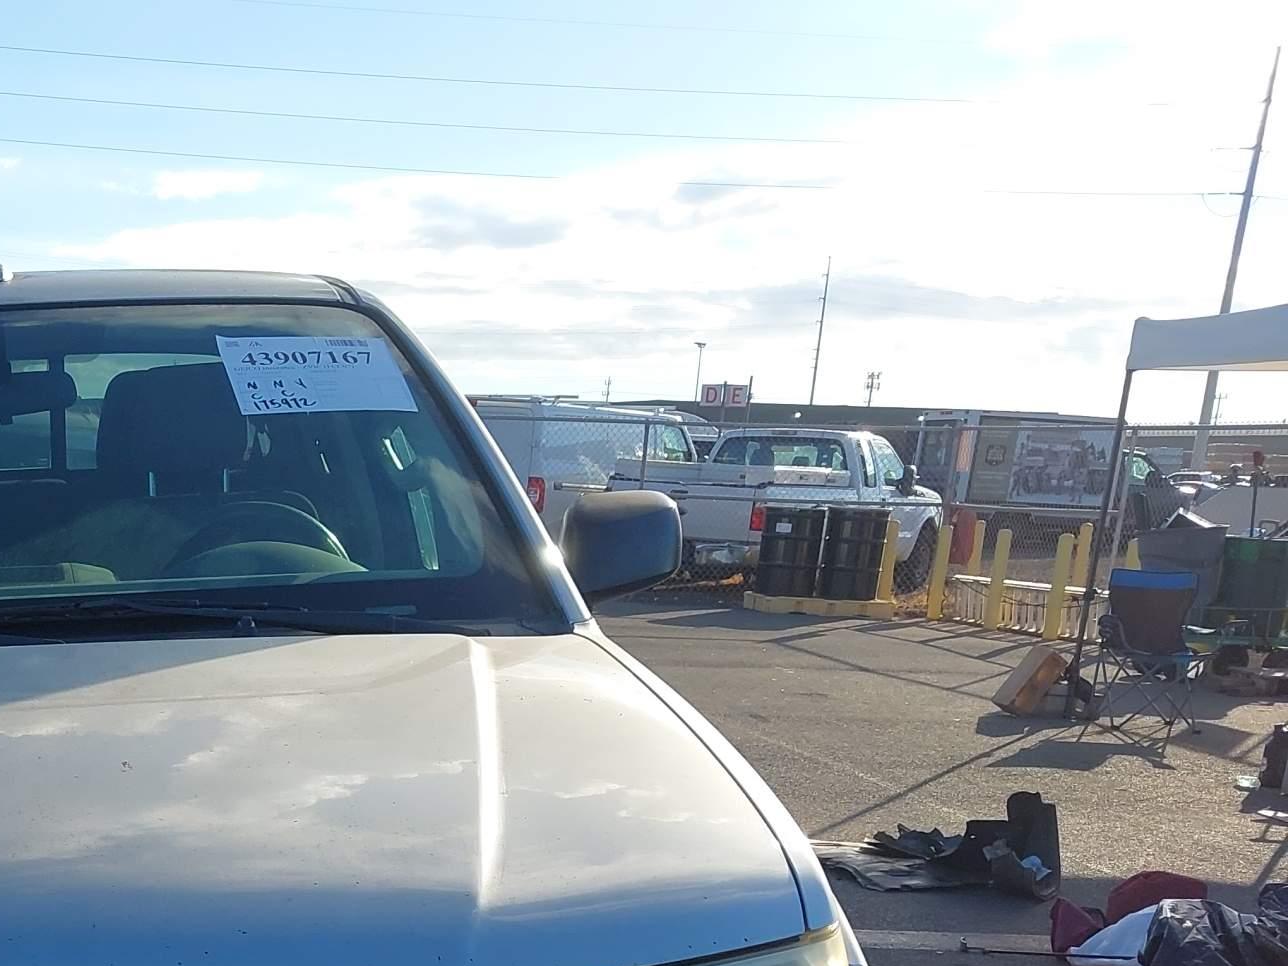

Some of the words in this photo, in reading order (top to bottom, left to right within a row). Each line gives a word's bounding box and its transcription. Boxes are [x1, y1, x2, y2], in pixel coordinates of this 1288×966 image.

[241, 350, 371, 366] 43907167
[705, 387, 718, 403] D
[732, 387, 744, 404] E
